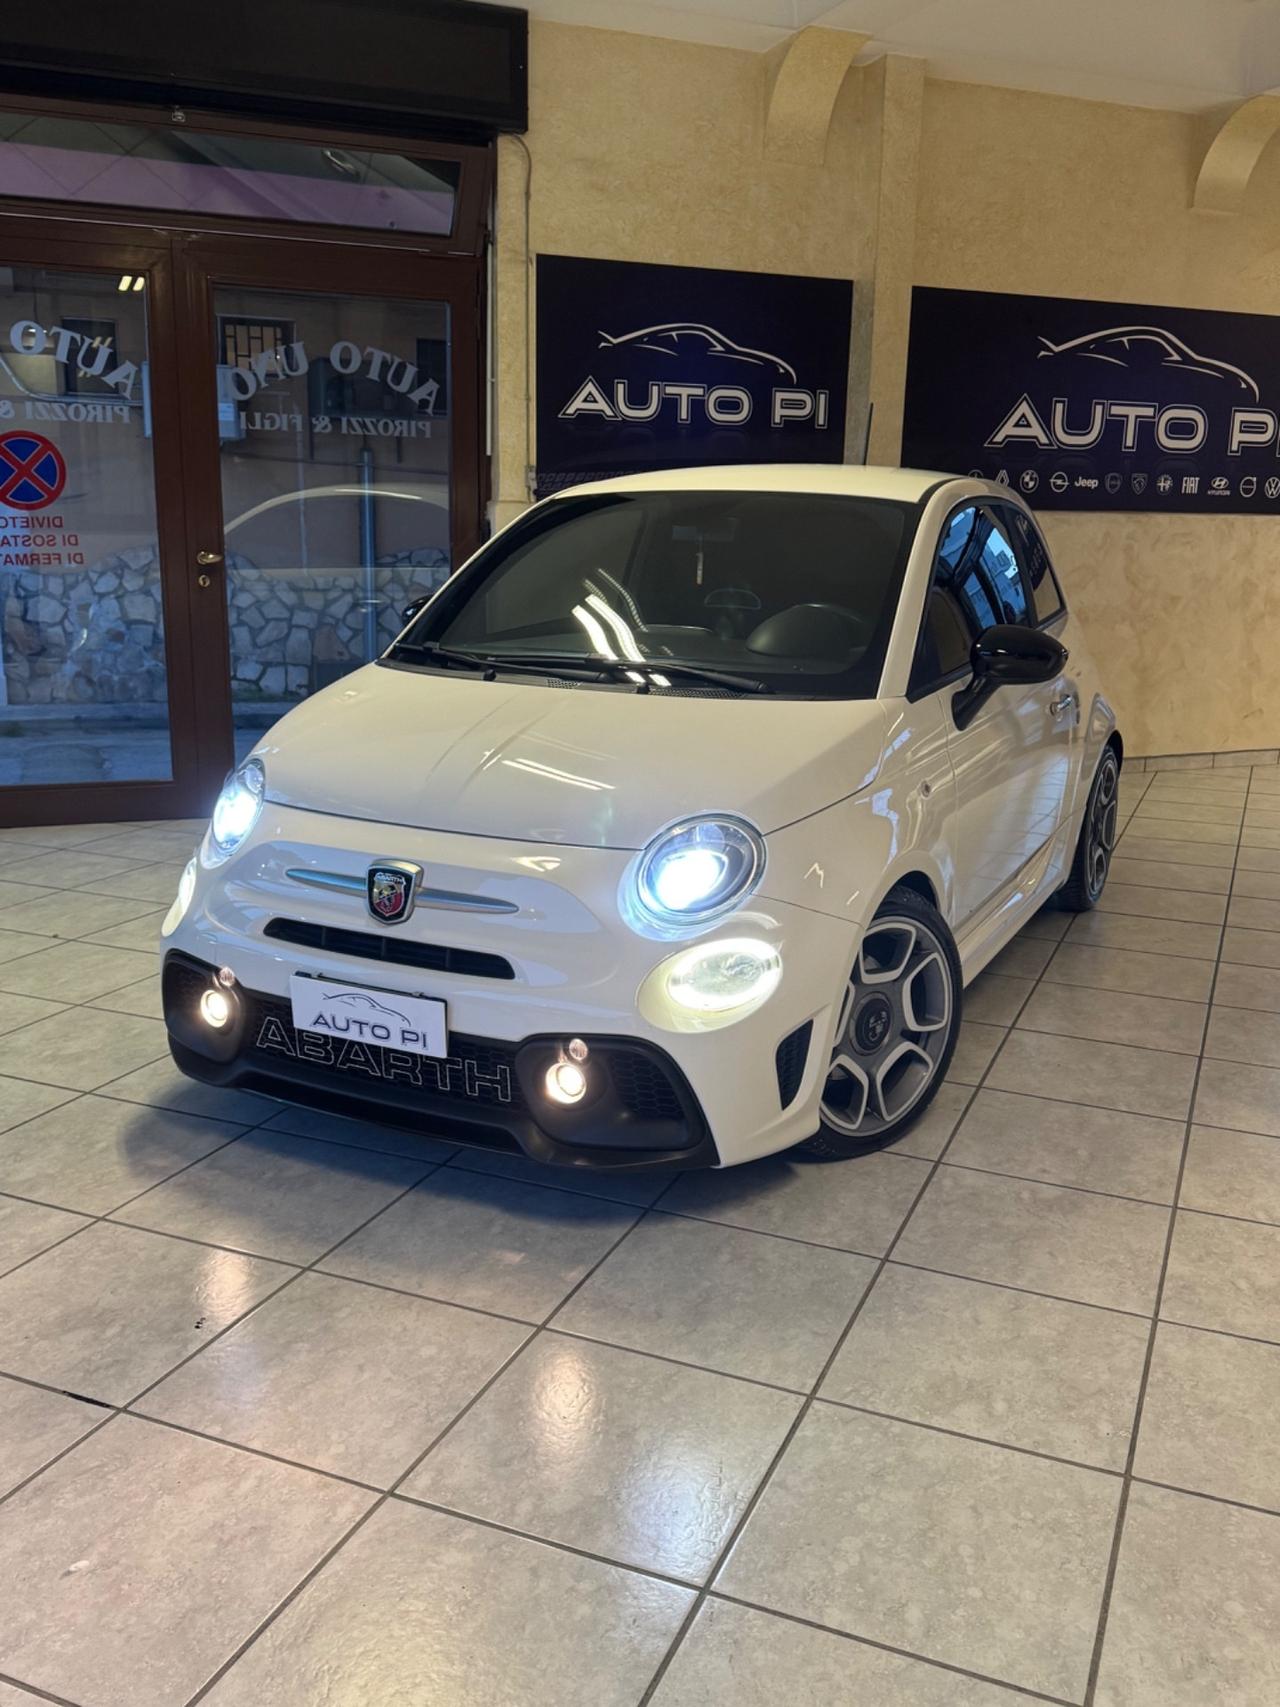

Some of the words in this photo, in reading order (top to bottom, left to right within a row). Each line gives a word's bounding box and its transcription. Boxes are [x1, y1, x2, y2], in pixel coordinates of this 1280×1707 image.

[558, 376, 752, 425] AUTO
[771, 388, 829, 429] PI
[984, 393, 1208, 454] AUTO
[1074, 476, 1099, 490] Jeep
[1181, 477, 1200, 494] FIAT
[311, 1012, 391, 1041] AUTO
[400, 1028, 427, 1049] PI
[256, 1016, 511, 1102] ABARTH
